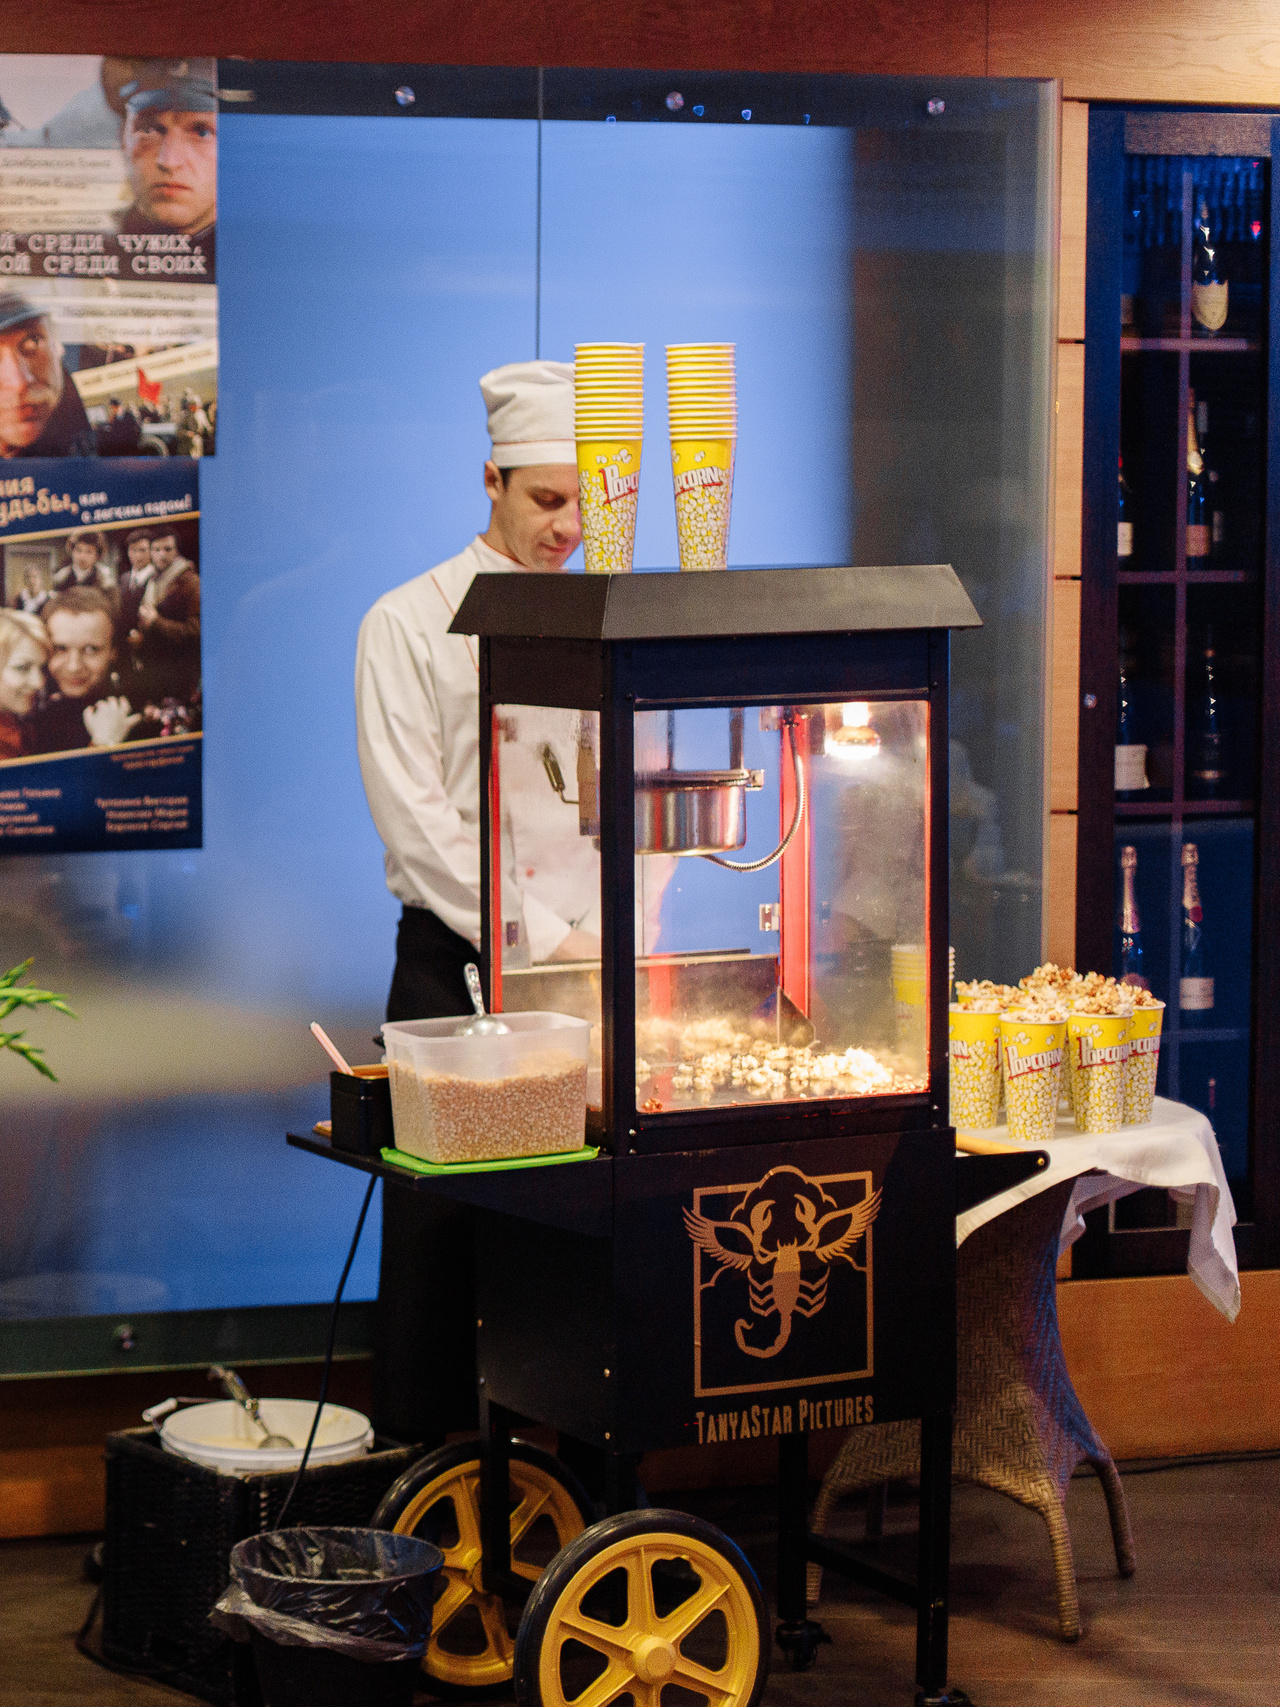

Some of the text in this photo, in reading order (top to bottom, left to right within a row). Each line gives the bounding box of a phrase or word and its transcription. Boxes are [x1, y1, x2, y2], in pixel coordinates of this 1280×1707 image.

[27, 234, 105, 255] СРЕДИ
[117, 234, 203, 256] ЧУЖИХ,
[42, 255, 121, 278] СРЕДИ
[130, 255, 208, 275] СВОИХ
